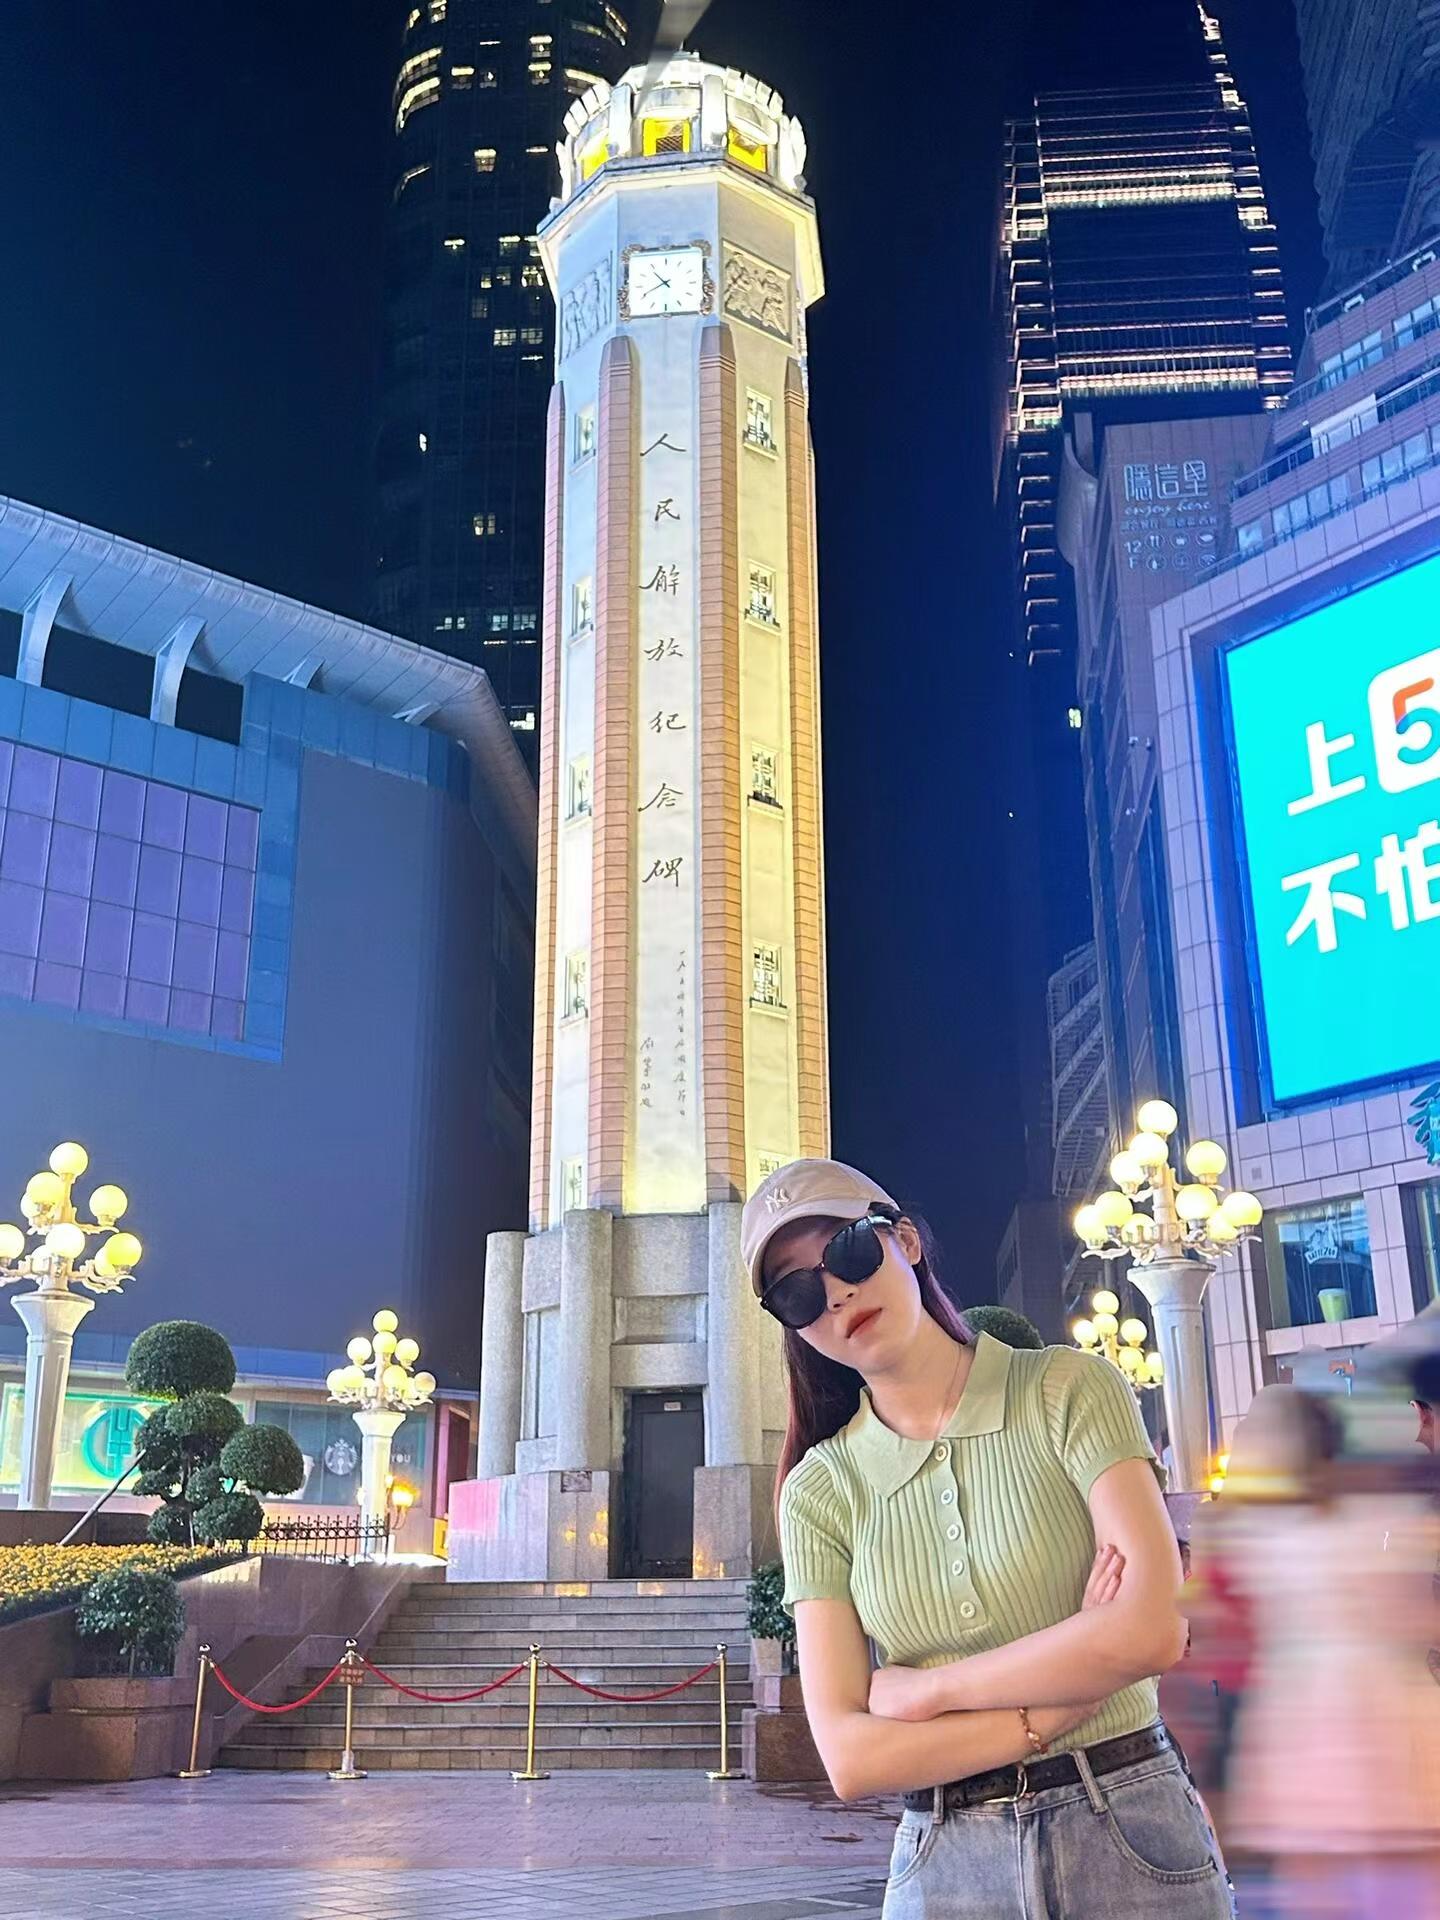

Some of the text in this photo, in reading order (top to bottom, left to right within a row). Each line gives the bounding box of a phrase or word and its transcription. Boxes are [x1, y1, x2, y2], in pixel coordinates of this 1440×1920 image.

[638, 433, 688, 888] 人民解放纪念碑
[1281, 819, 1440, 954] 不怕
[765, 1187, 790, 1213] NY
